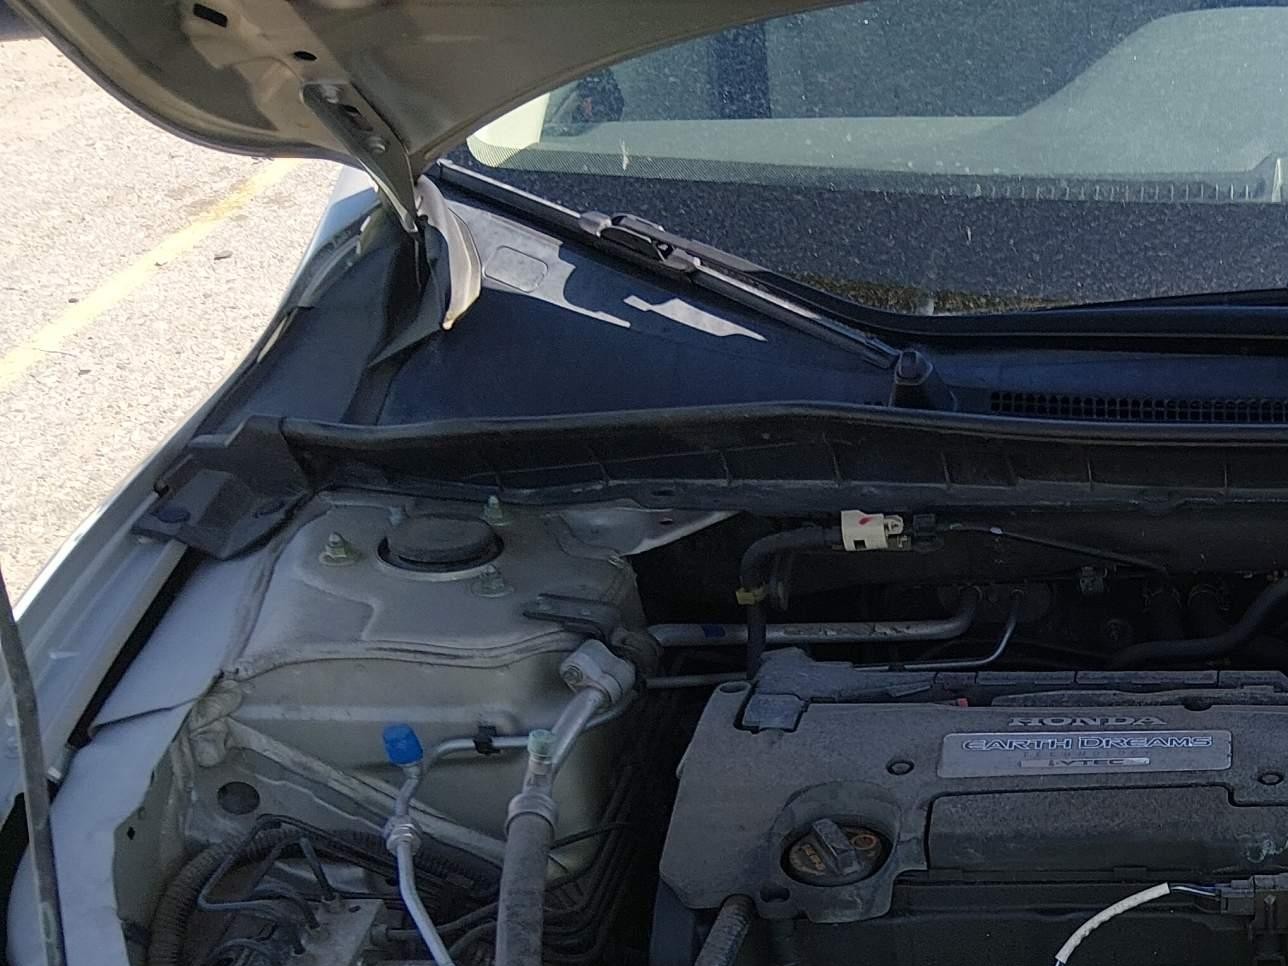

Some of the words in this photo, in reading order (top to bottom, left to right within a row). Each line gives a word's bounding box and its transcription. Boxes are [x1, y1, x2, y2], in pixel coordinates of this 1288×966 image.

[1008, 716, 1167, 727] HONDA
[962, 737, 1072, 751] EARTH
[1078, 735, 1214, 750] DREAMS
